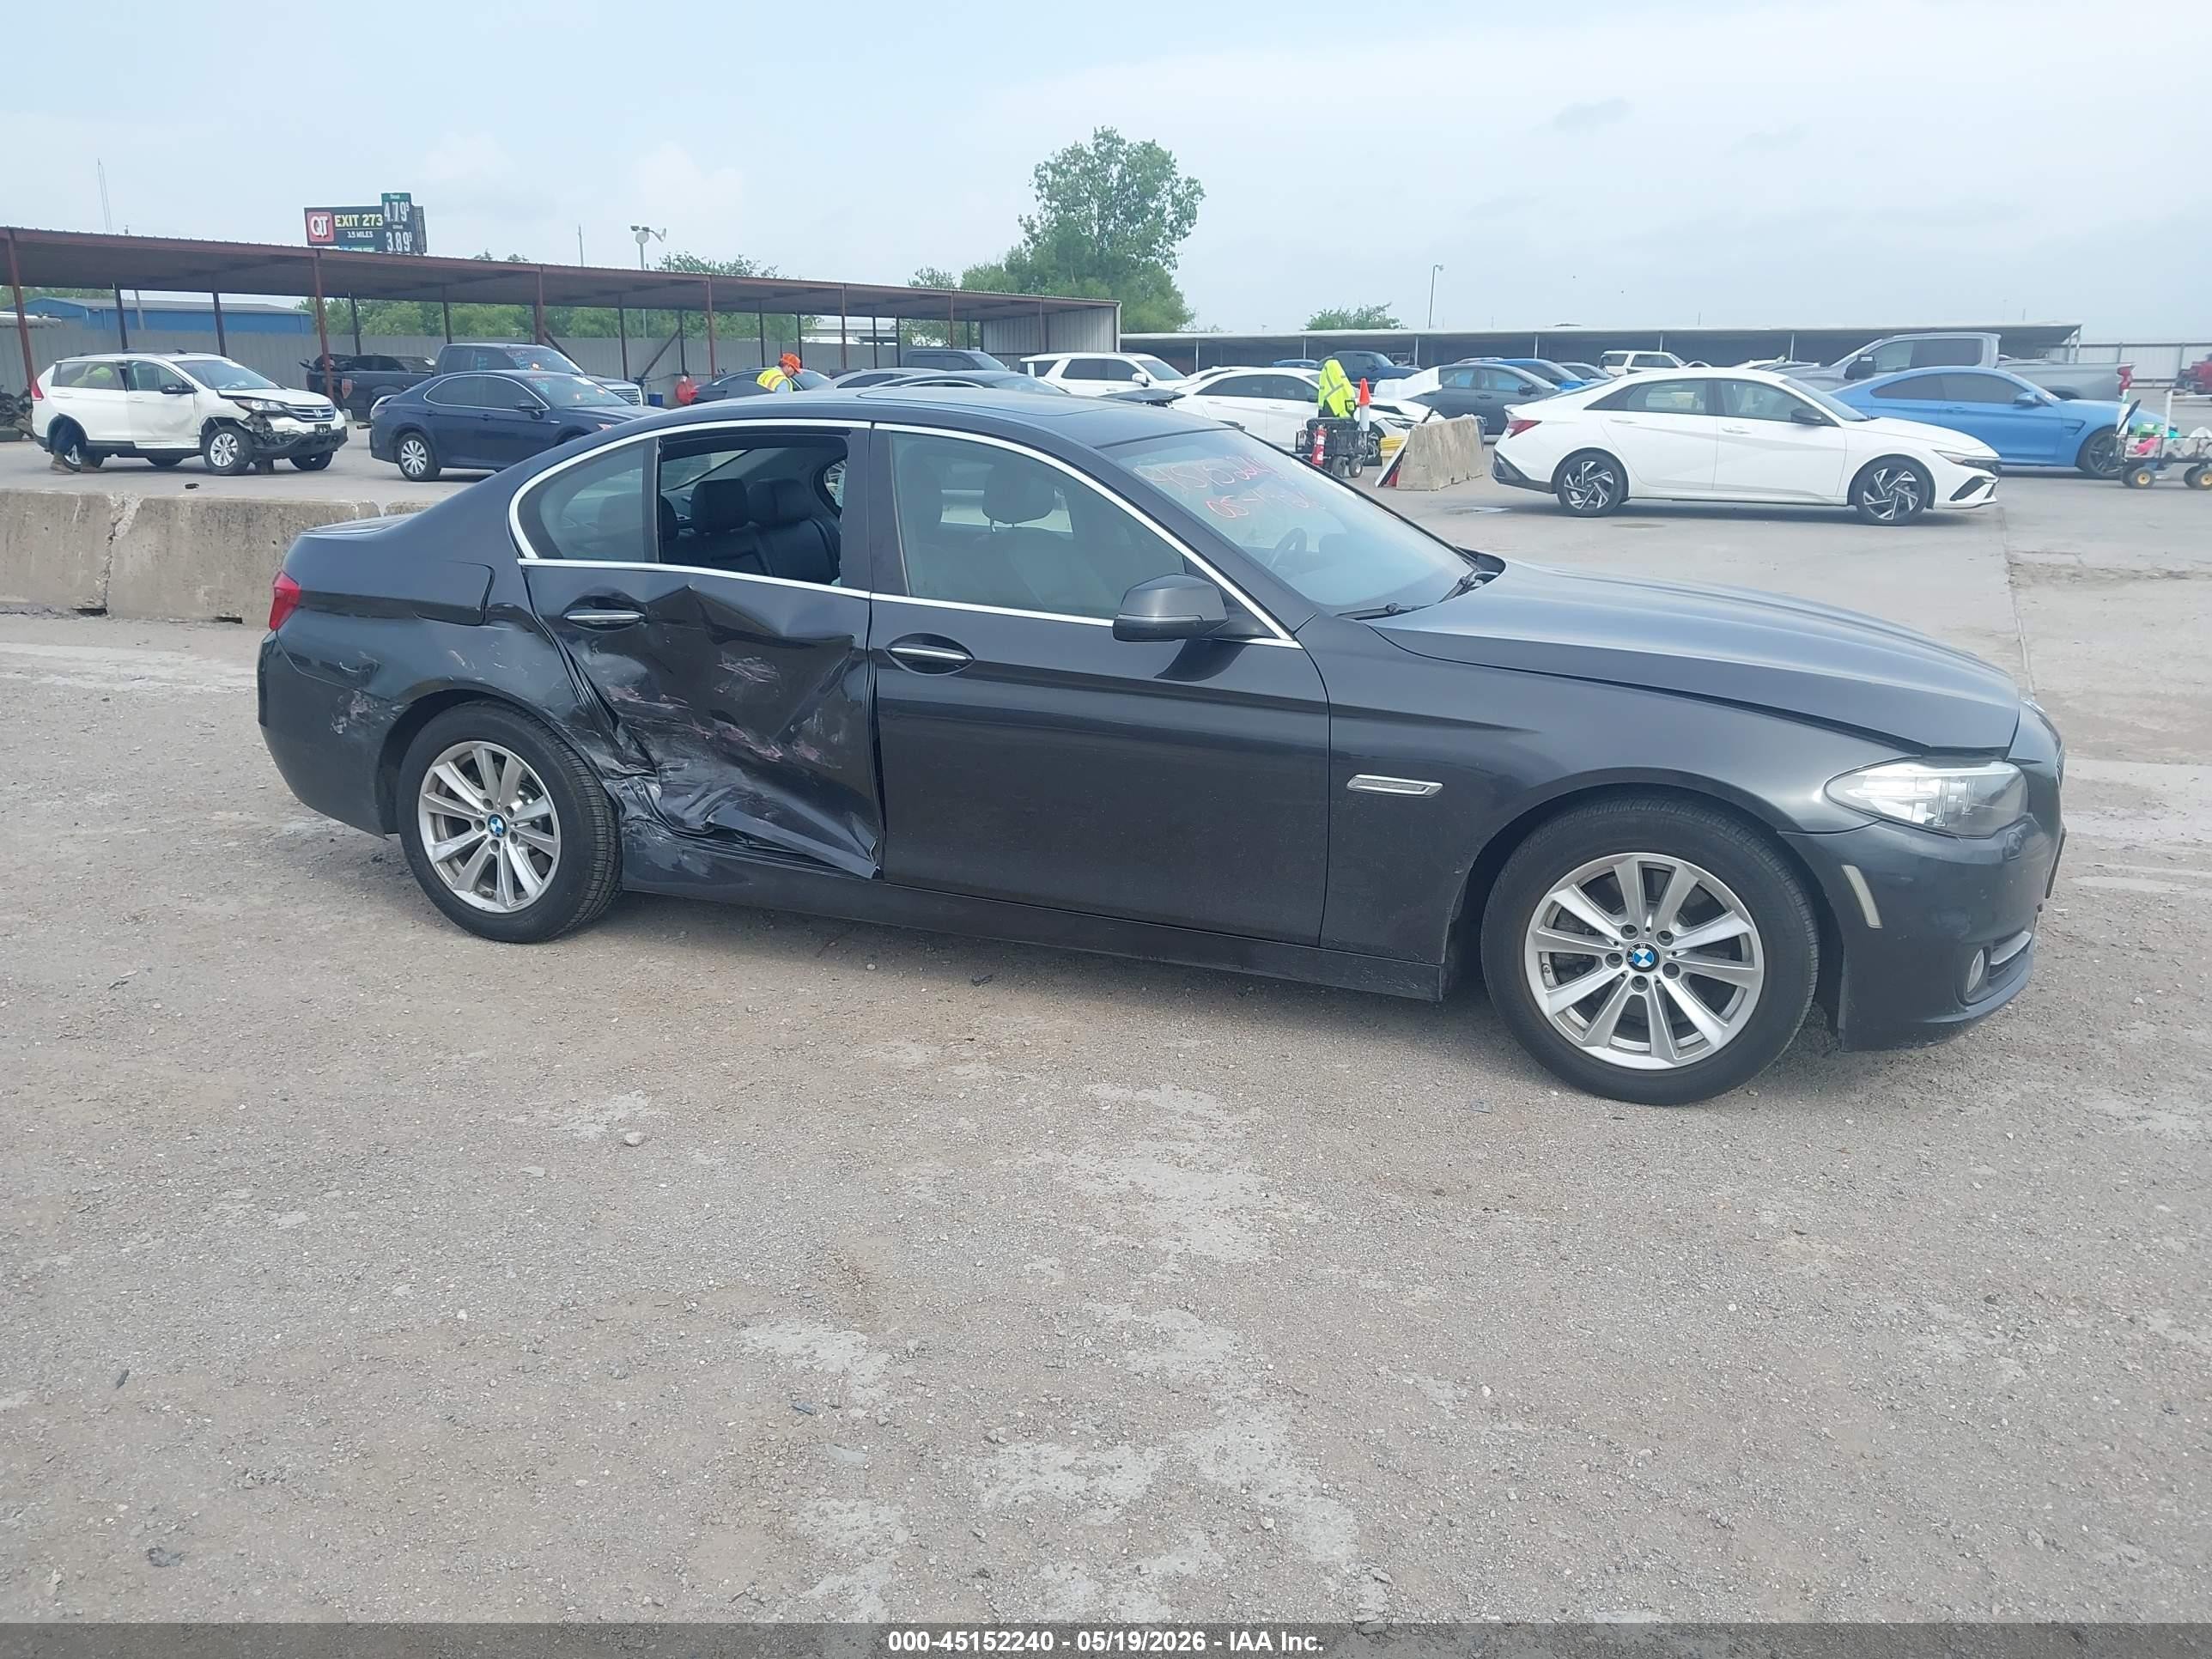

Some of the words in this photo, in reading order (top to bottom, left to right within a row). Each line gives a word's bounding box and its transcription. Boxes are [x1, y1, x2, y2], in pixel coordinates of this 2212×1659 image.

[310, 216, 329, 237] QT
[334, 214, 359, 228] EXIT
[362, 213, 384, 227] 273
[356, 230, 374, 239] MILES
